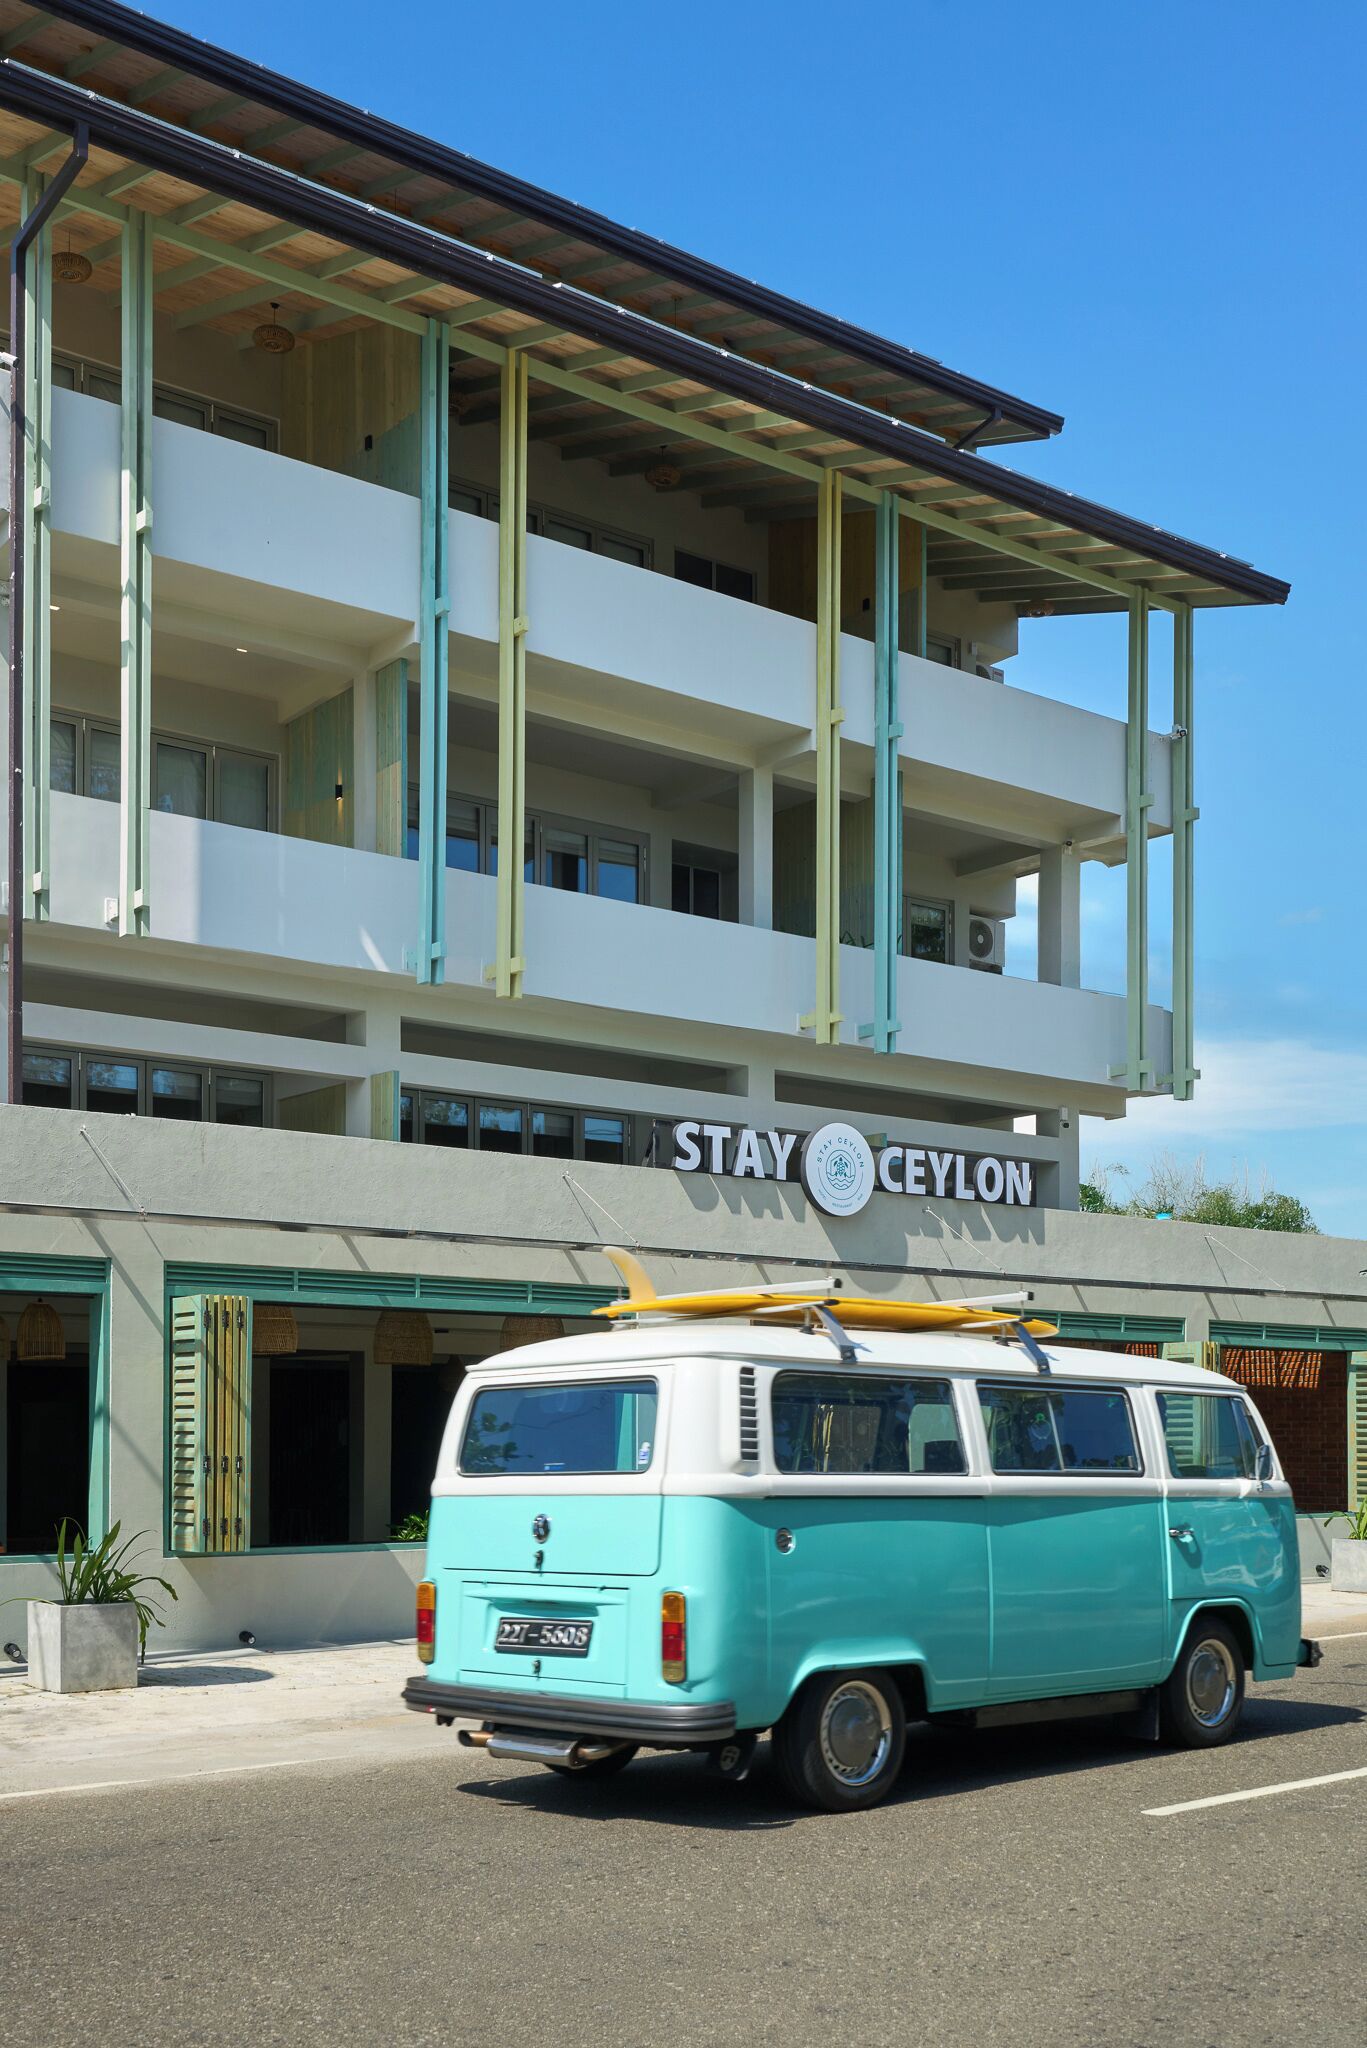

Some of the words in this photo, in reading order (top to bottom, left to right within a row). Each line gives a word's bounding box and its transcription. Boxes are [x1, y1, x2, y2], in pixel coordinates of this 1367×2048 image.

[674, 1121, 797, 1180] STAY
[879, 1146, 1031, 1205] CEYLON
[817, 1139, 832, 1163] STAY
[837, 1137, 864, 1168] CEYLON
